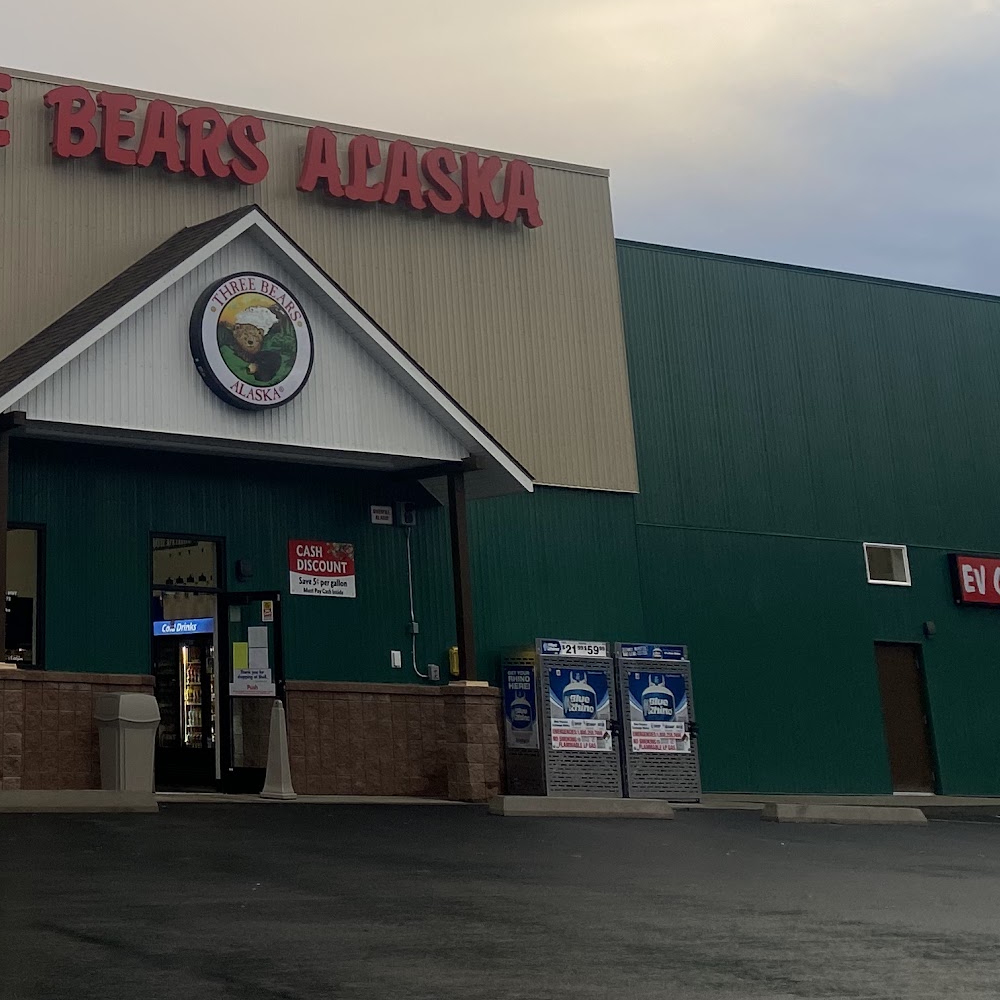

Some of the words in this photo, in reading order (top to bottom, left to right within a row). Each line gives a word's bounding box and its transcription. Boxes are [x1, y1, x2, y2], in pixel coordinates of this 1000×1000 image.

[44, 84, 269, 186] BEARS
[296, 125, 544, 229] ALASKA
[212, 277, 257, 307] THREE
[260, 279, 302, 322] BEARS
[230, 380, 281, 402] ALASKA
[295, 544, 323, 558] CASH
[296, 558, 348, 574] DISCOUNT
[298, 576, 312, 585] Save
[320, 580, 330, 588] per
[330, 579, 348, 588] gallon
[962, 564, 986, 595] EV
[176, 622, 197, 632] Drinks
[508, 675, 531, 683] RHINO
[570, 694, 590, 704] Blue
[648, 697, 669, 707] Blue
